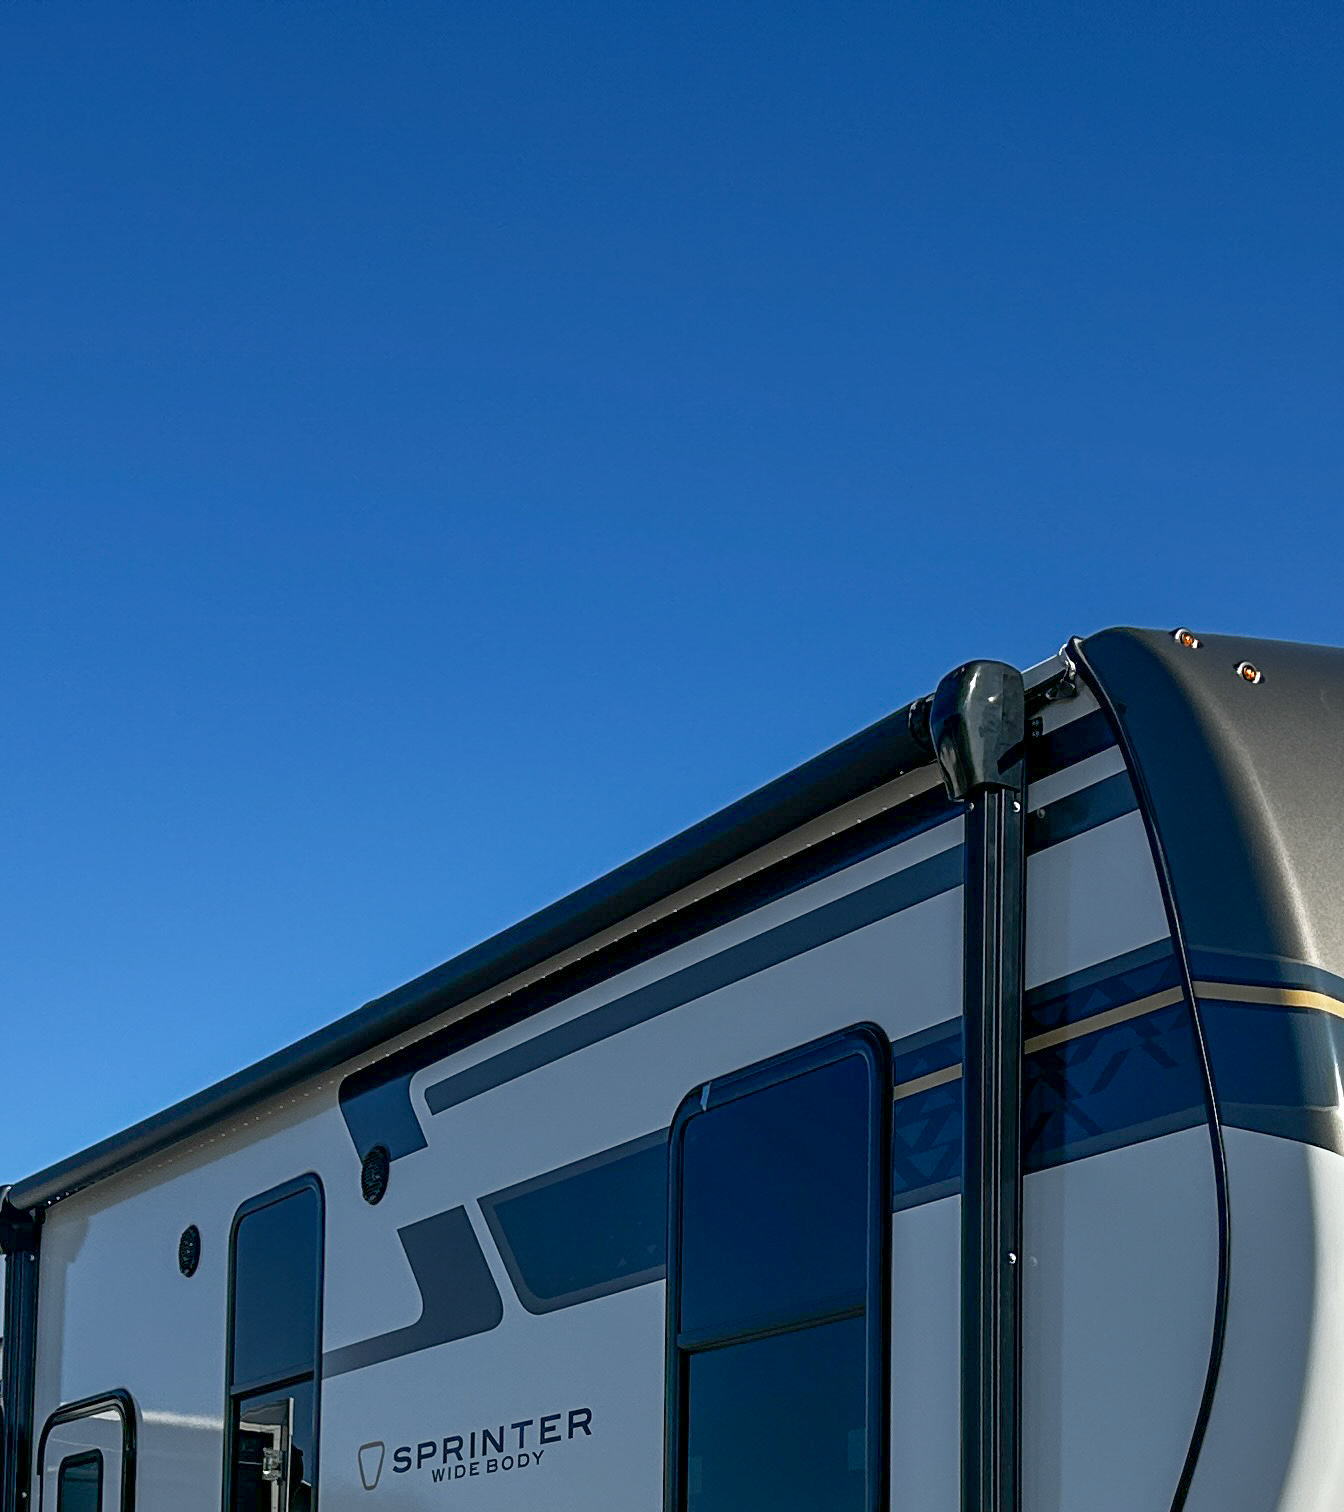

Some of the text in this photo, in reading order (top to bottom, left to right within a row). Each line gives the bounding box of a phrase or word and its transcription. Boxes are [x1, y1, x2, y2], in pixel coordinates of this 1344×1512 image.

[392, 1407, 593, 1474] SPRINTER
[431, 1450, 545, 1483] WIDE BODY
